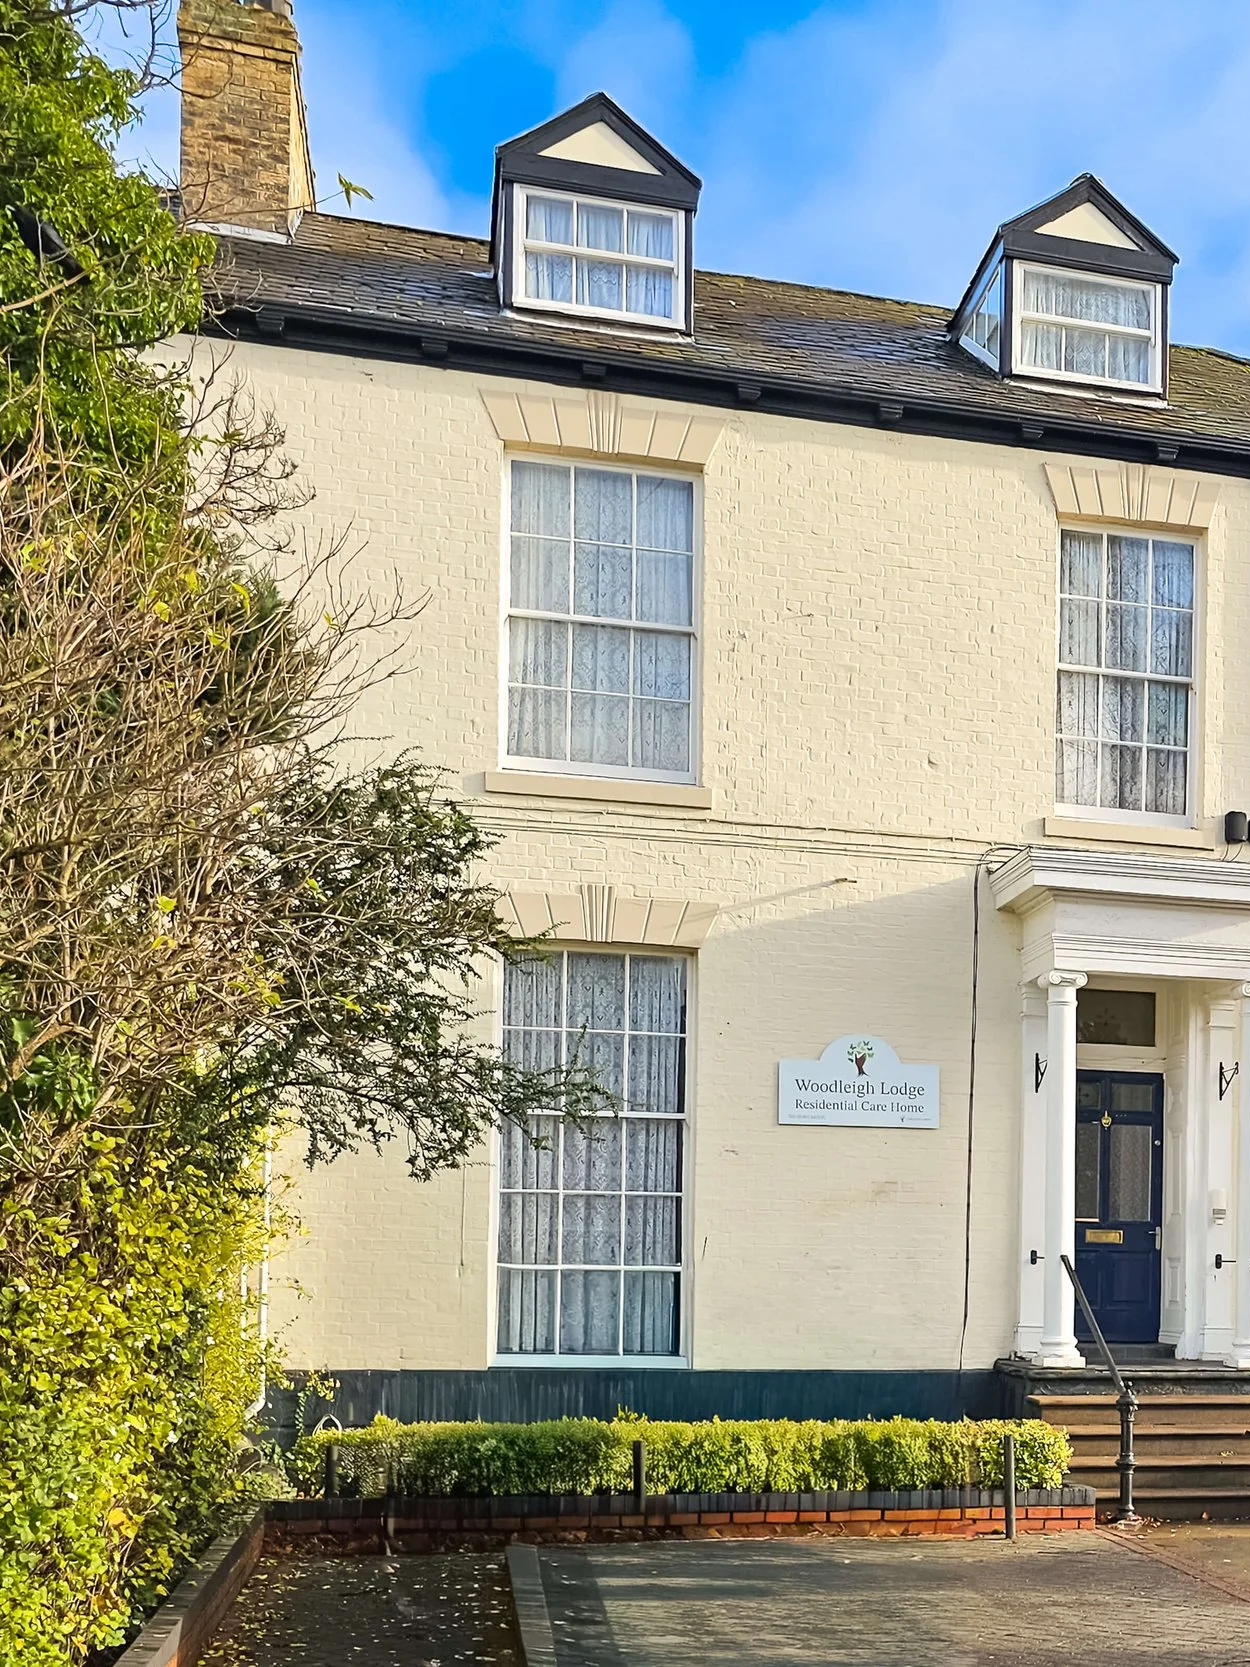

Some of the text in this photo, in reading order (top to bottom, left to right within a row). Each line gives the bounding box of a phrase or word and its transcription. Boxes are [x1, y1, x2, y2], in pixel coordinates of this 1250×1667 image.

[795, 1079, 926, 1100] Woodleigh Lodge
[795, 1099, 925, 1113] Residential Care Home
